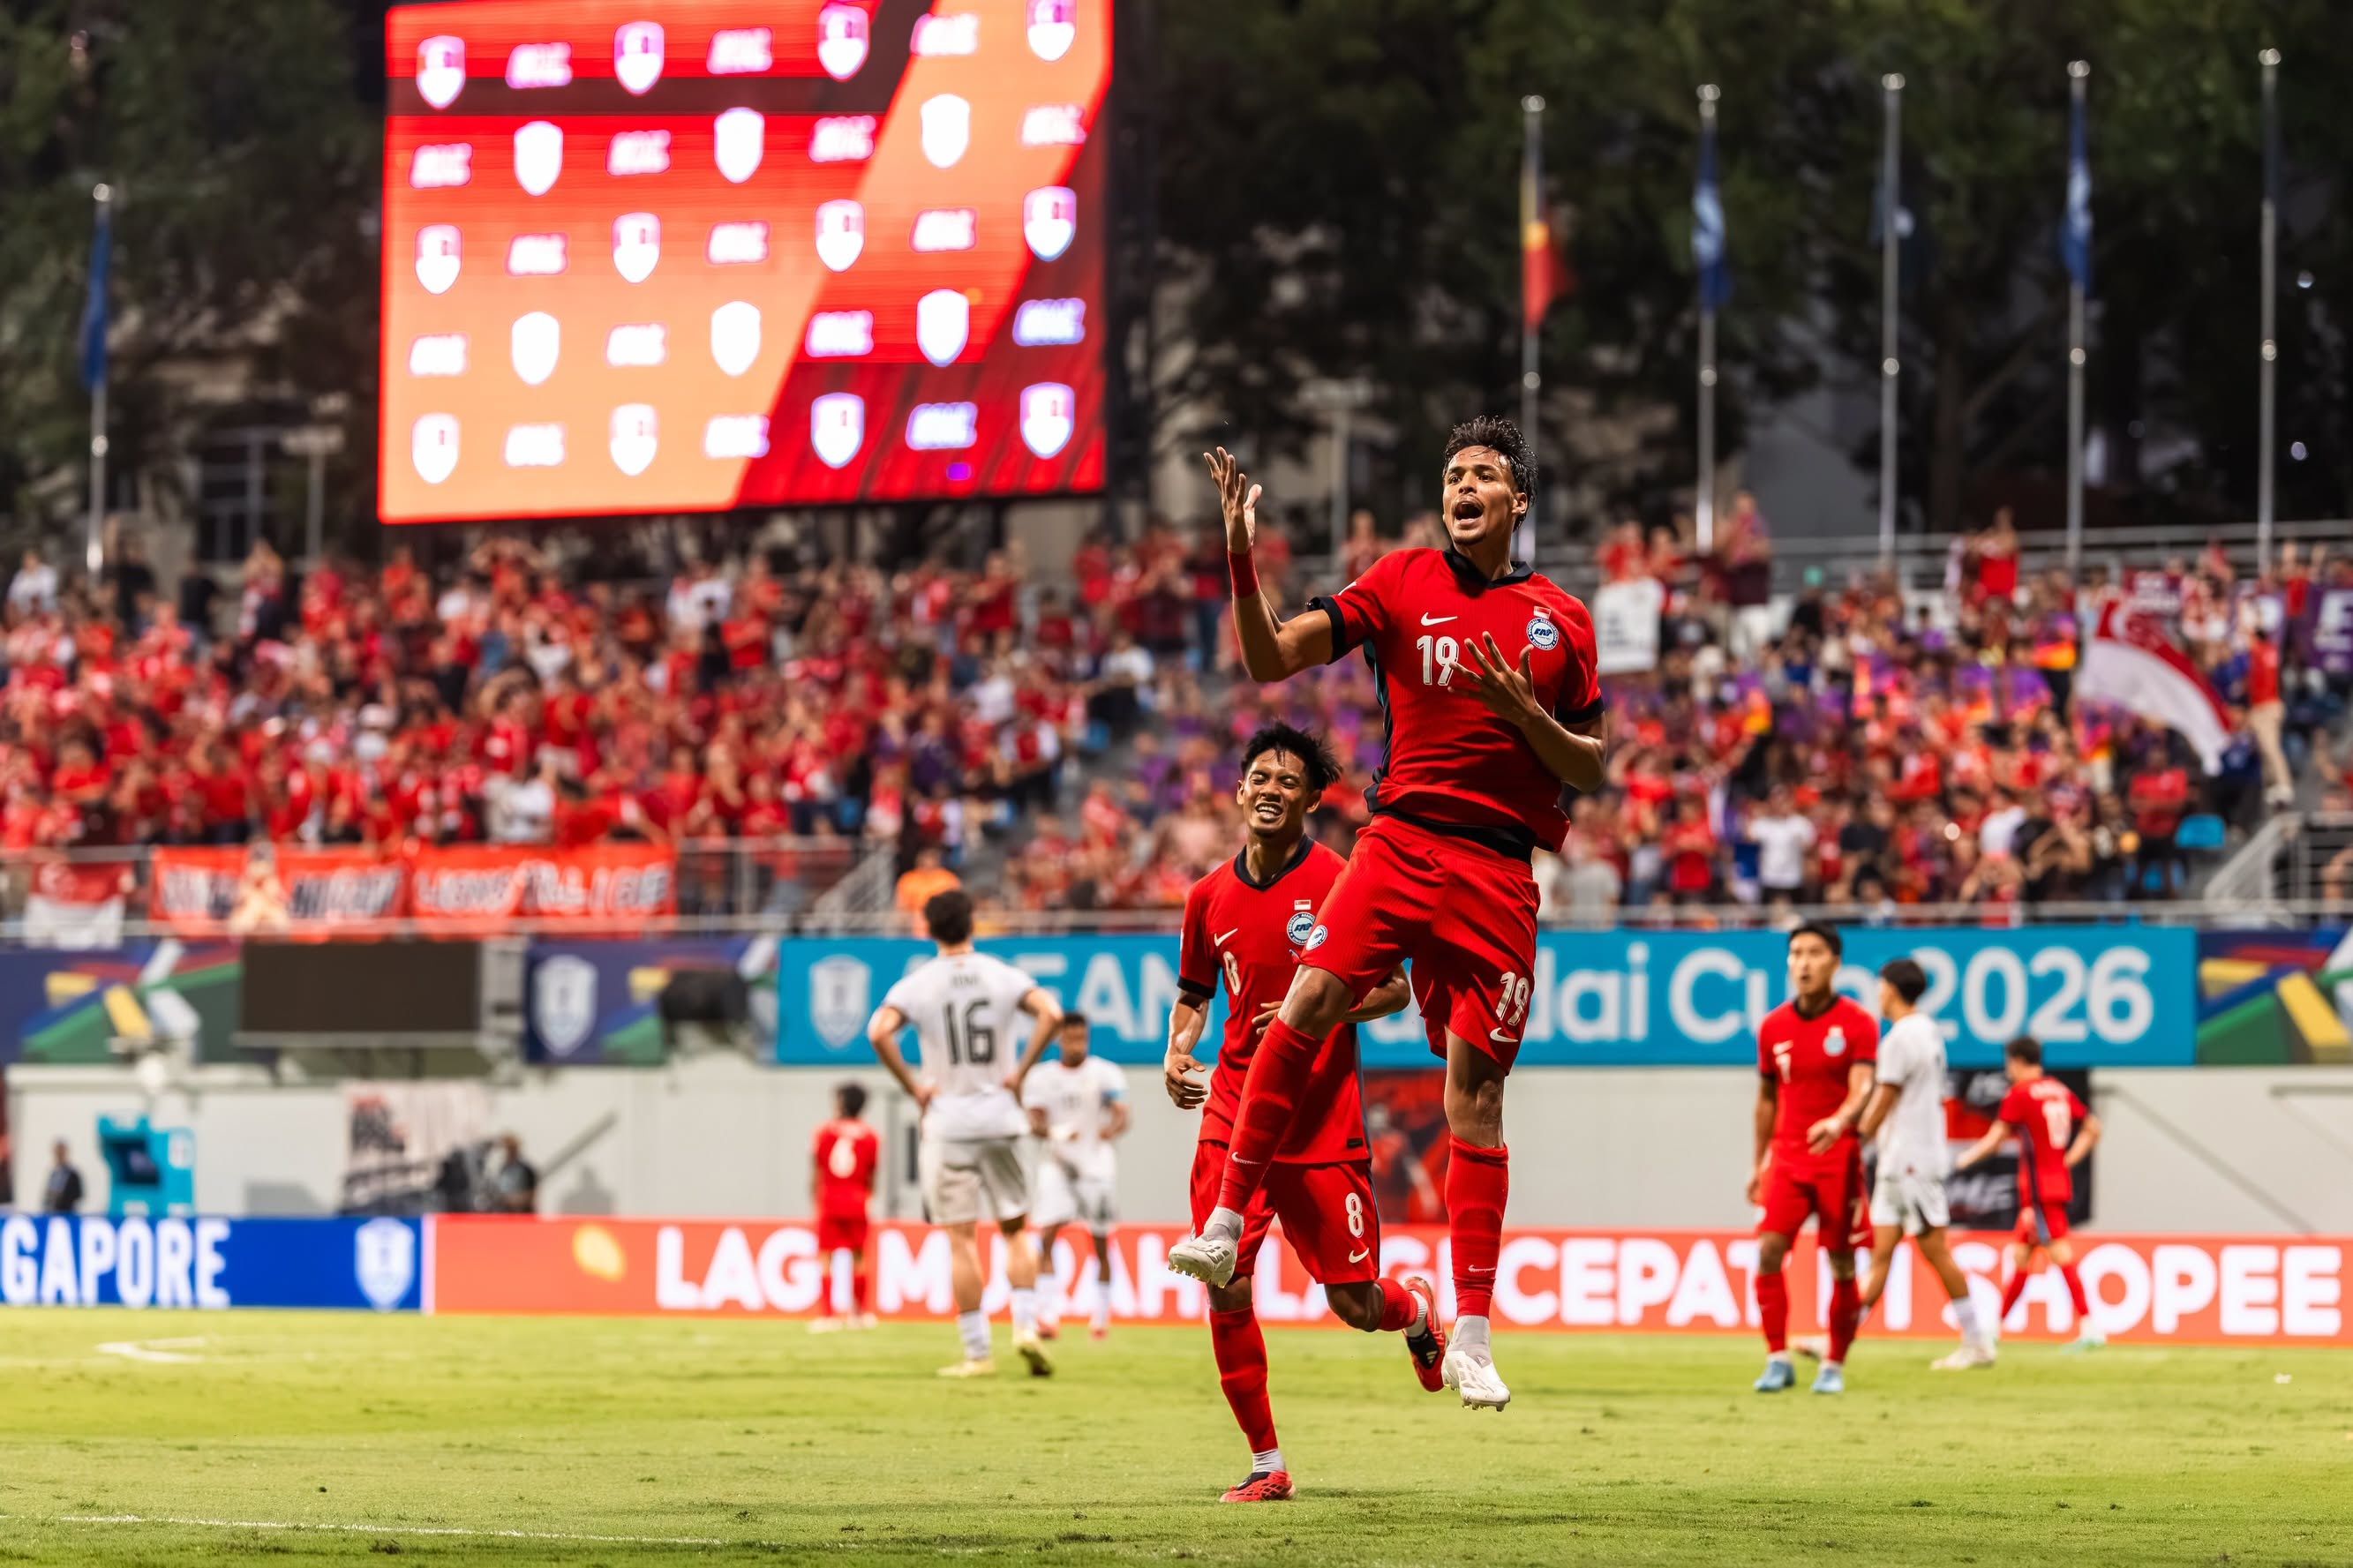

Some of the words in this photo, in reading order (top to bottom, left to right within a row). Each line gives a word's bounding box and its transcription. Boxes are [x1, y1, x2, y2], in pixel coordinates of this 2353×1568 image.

[1417, 634, 1460, 686] 19
[1223, 951, 1241, 995] 8
[1495, 971, 1530, 1026] 19
[1908, 945, 2154, 1044] 2026
[943, 997, 997, 1066] 16
[1345, 1192, 1364, 1239] 8
[1, 1214, 231, 1309] GAPORE
[656, 1225, 855, 1312] LAGI
[1254, 1234, 1456, 1321] LGI
[1942, 1242, 2342, 1336] SHOPEE
